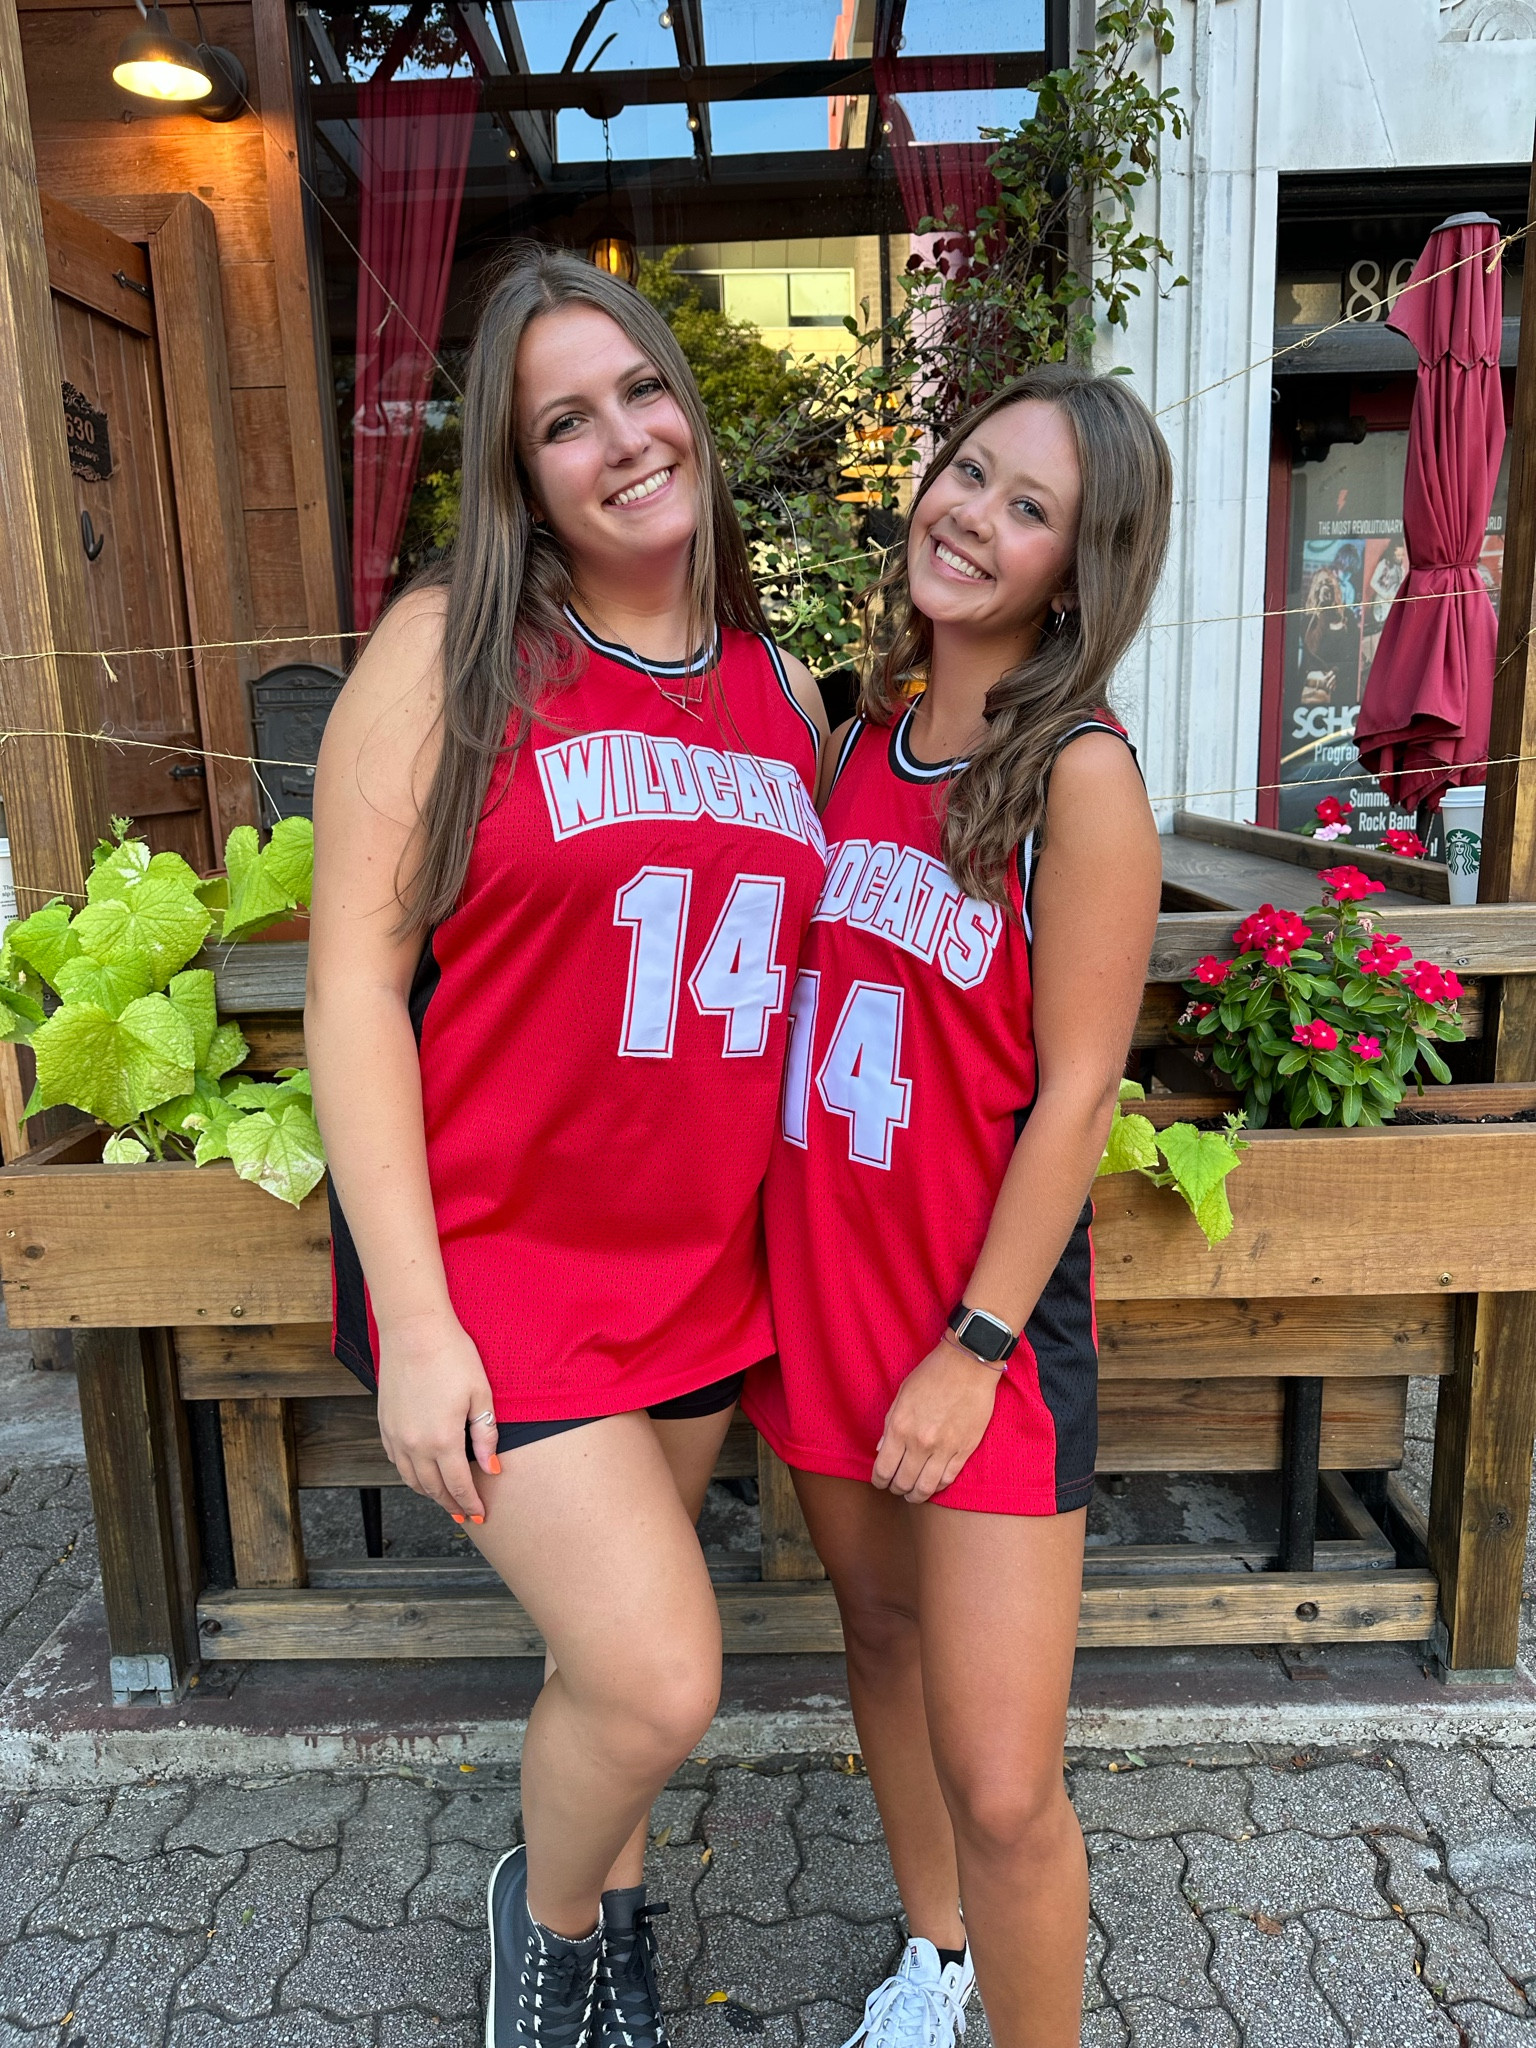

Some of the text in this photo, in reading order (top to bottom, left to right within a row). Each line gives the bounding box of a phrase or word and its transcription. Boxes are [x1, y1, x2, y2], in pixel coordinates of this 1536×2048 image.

[1319, 520, 1331, 536] THE
[1332, 520, 1351, 535] MOST
[1352, 519, 1404, 534] REVOLUTIONARY
[535, 730, 827, 867] WILDCATS
[1358, 810, 1417, 832] Rock Band
[613, 866, 786, 1059] 14
[780, 968, 913, 1171] 14
